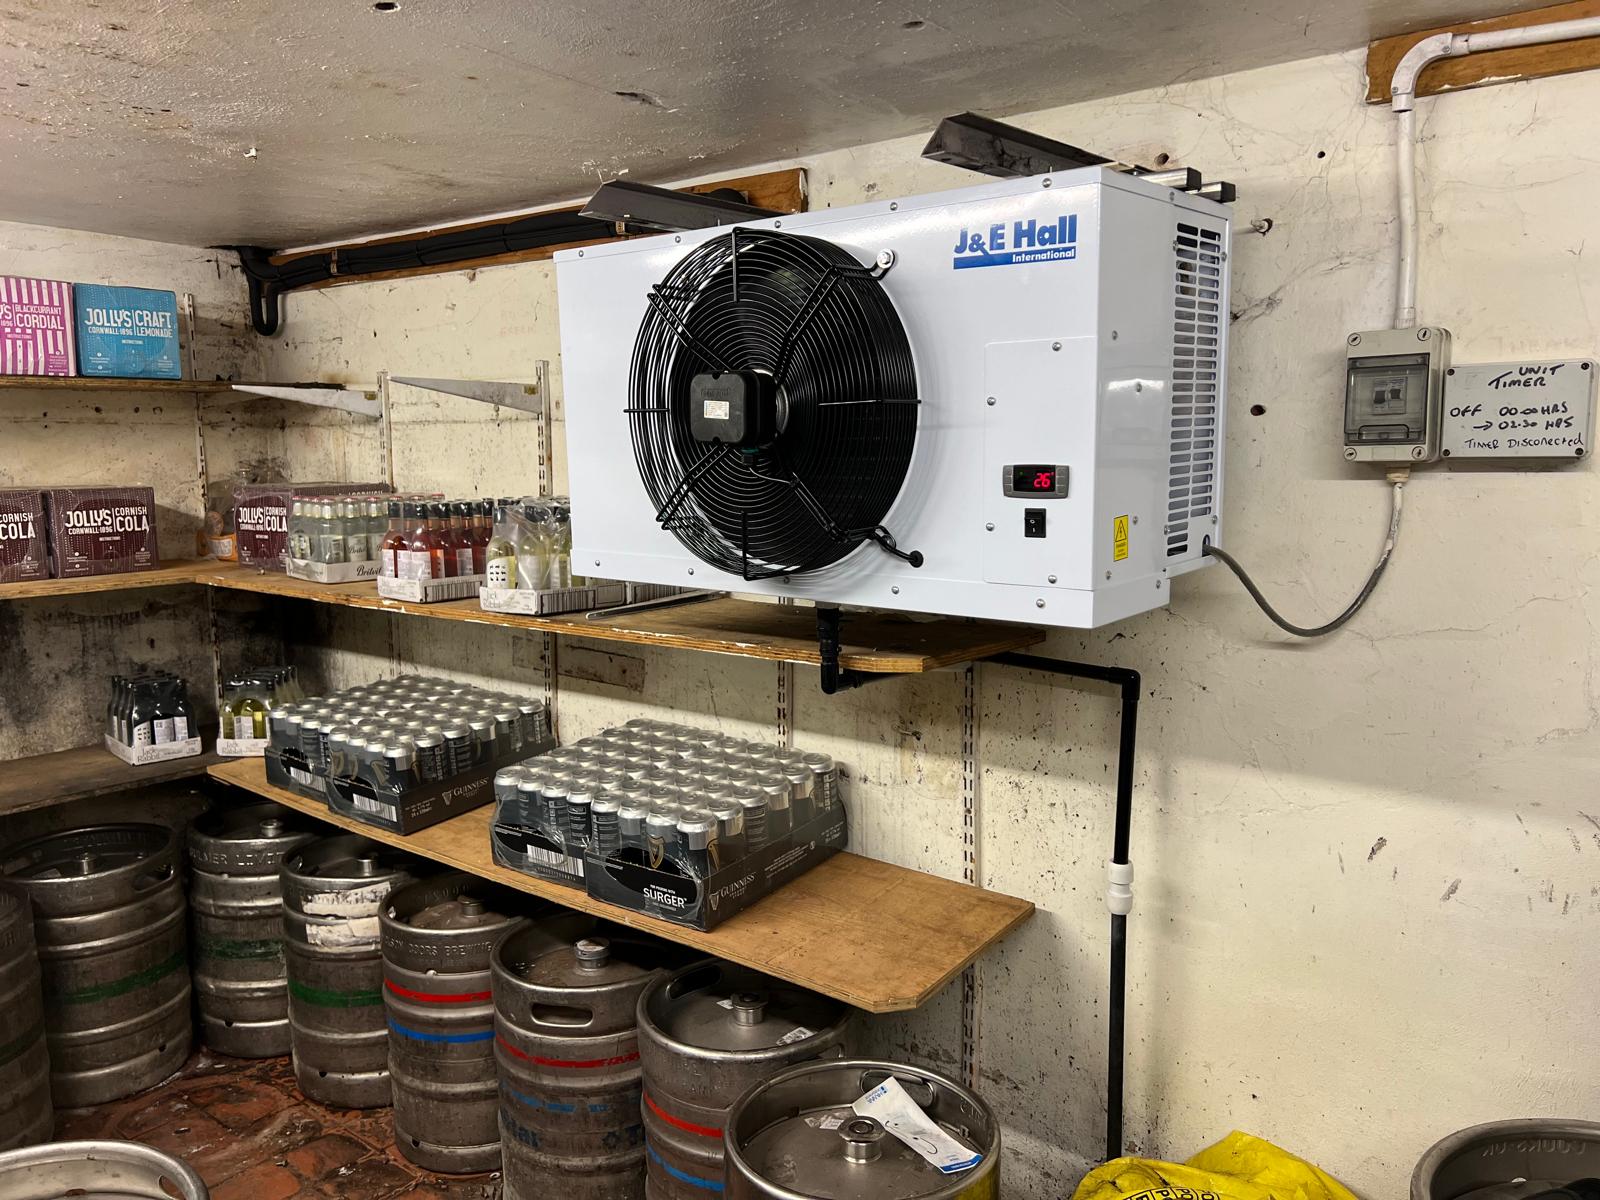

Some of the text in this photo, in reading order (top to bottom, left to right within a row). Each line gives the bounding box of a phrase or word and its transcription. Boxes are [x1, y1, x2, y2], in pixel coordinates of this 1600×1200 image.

[954, 214, 1077, 256] J&E Hall
[1012, 249, 1075, 263] International
[15, 304, 61, 315] BLACKCURRANT
[85, 308, 171, 328] JOLLY'S CRAFT
[16, 313, 64, 330] CORDIAL
[136, 327, 173, 338] LEMONADE
[1518, 364, 1565, 376] UNIT
[1450, 404, 1482, 417] OFF
[1540, 401, 1568, 415] HRS
[1545, 416, 1574, 430] HRS
[65, 506, 147, 527] JOLLY'S CORNISH
[238, 506, 287, 523] JOLLY'S CORNISH
[0, 521, 36, 540] COLA
[116, 515, 149, 532] COLA
[266, 515, 288, 532] COLA
[356, 564, 382, 577] Britvi
[453, 778, 488, 797] GUINNESS
[720, 873, 756, 897] GUINNESS
[643, 887, 685, 909] SURGER
